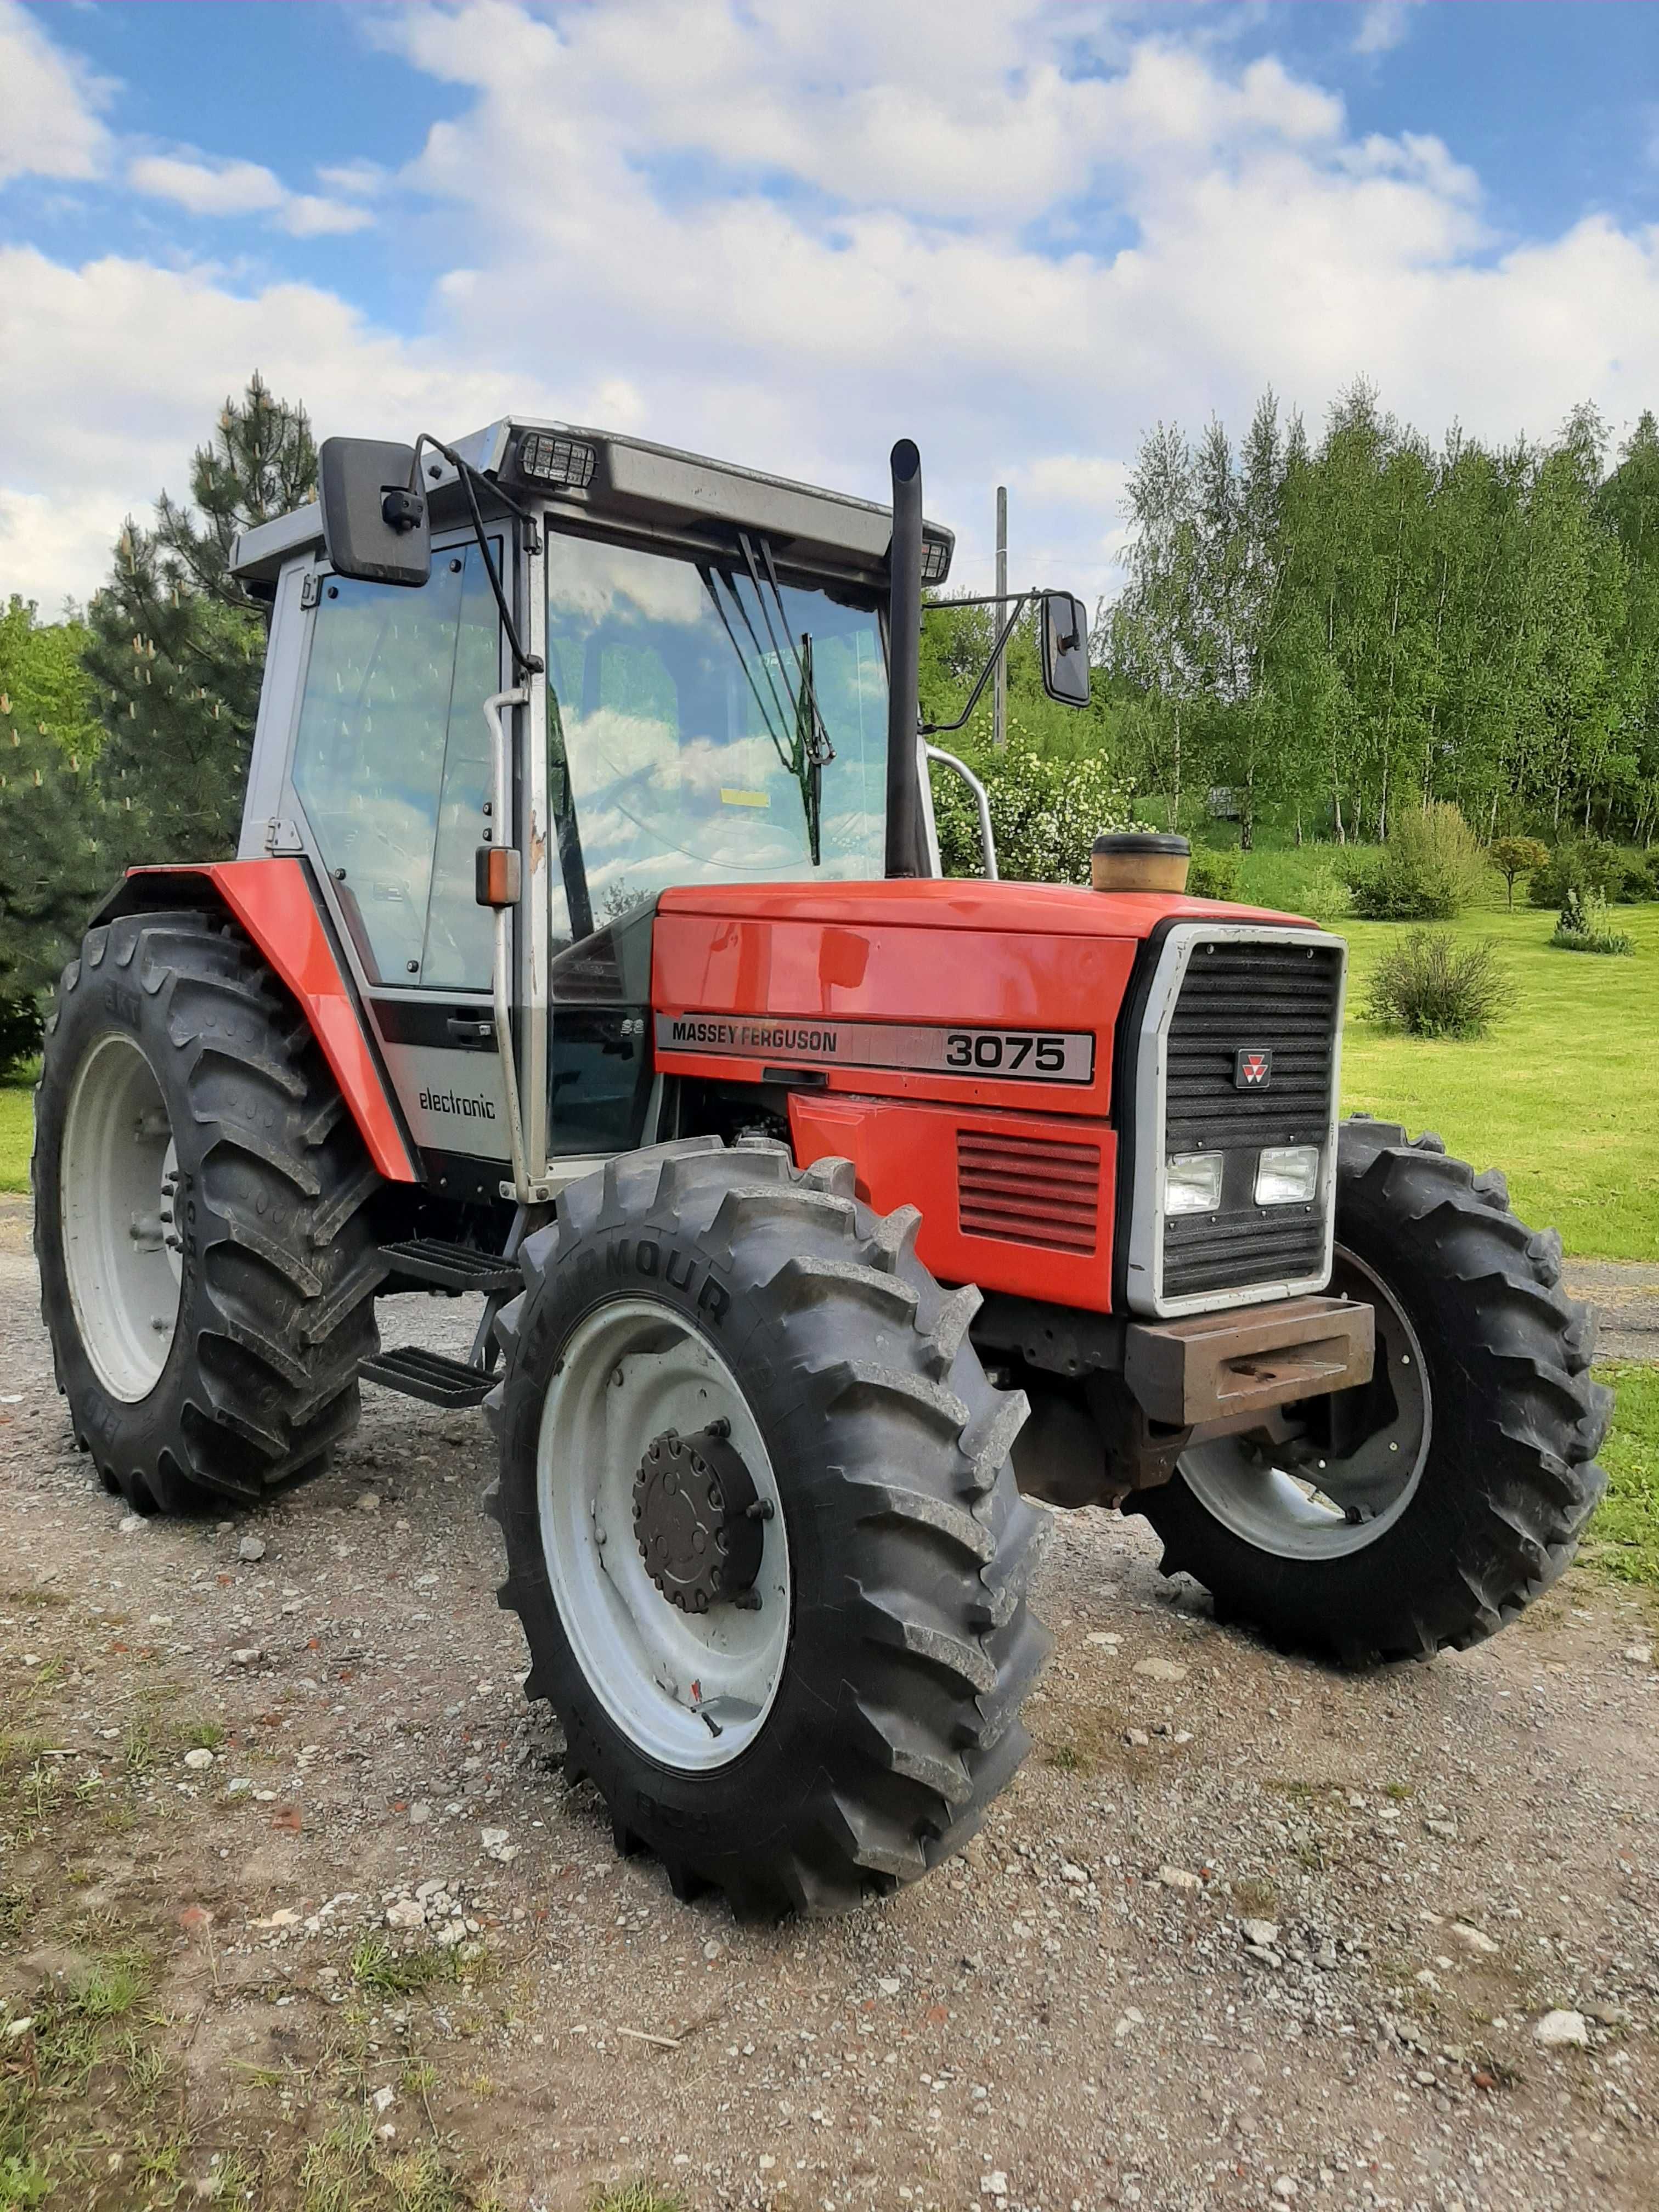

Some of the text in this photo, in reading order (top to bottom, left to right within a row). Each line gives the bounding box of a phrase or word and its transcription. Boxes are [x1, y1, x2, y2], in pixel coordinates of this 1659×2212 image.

[672, 1022, 738, 1044] MASSEY
[741, 1025, 837, 1052] FERGUSON
[946, 1034, 1065, 1071] 3075
[419, 1087, 495, 1120] electronic
